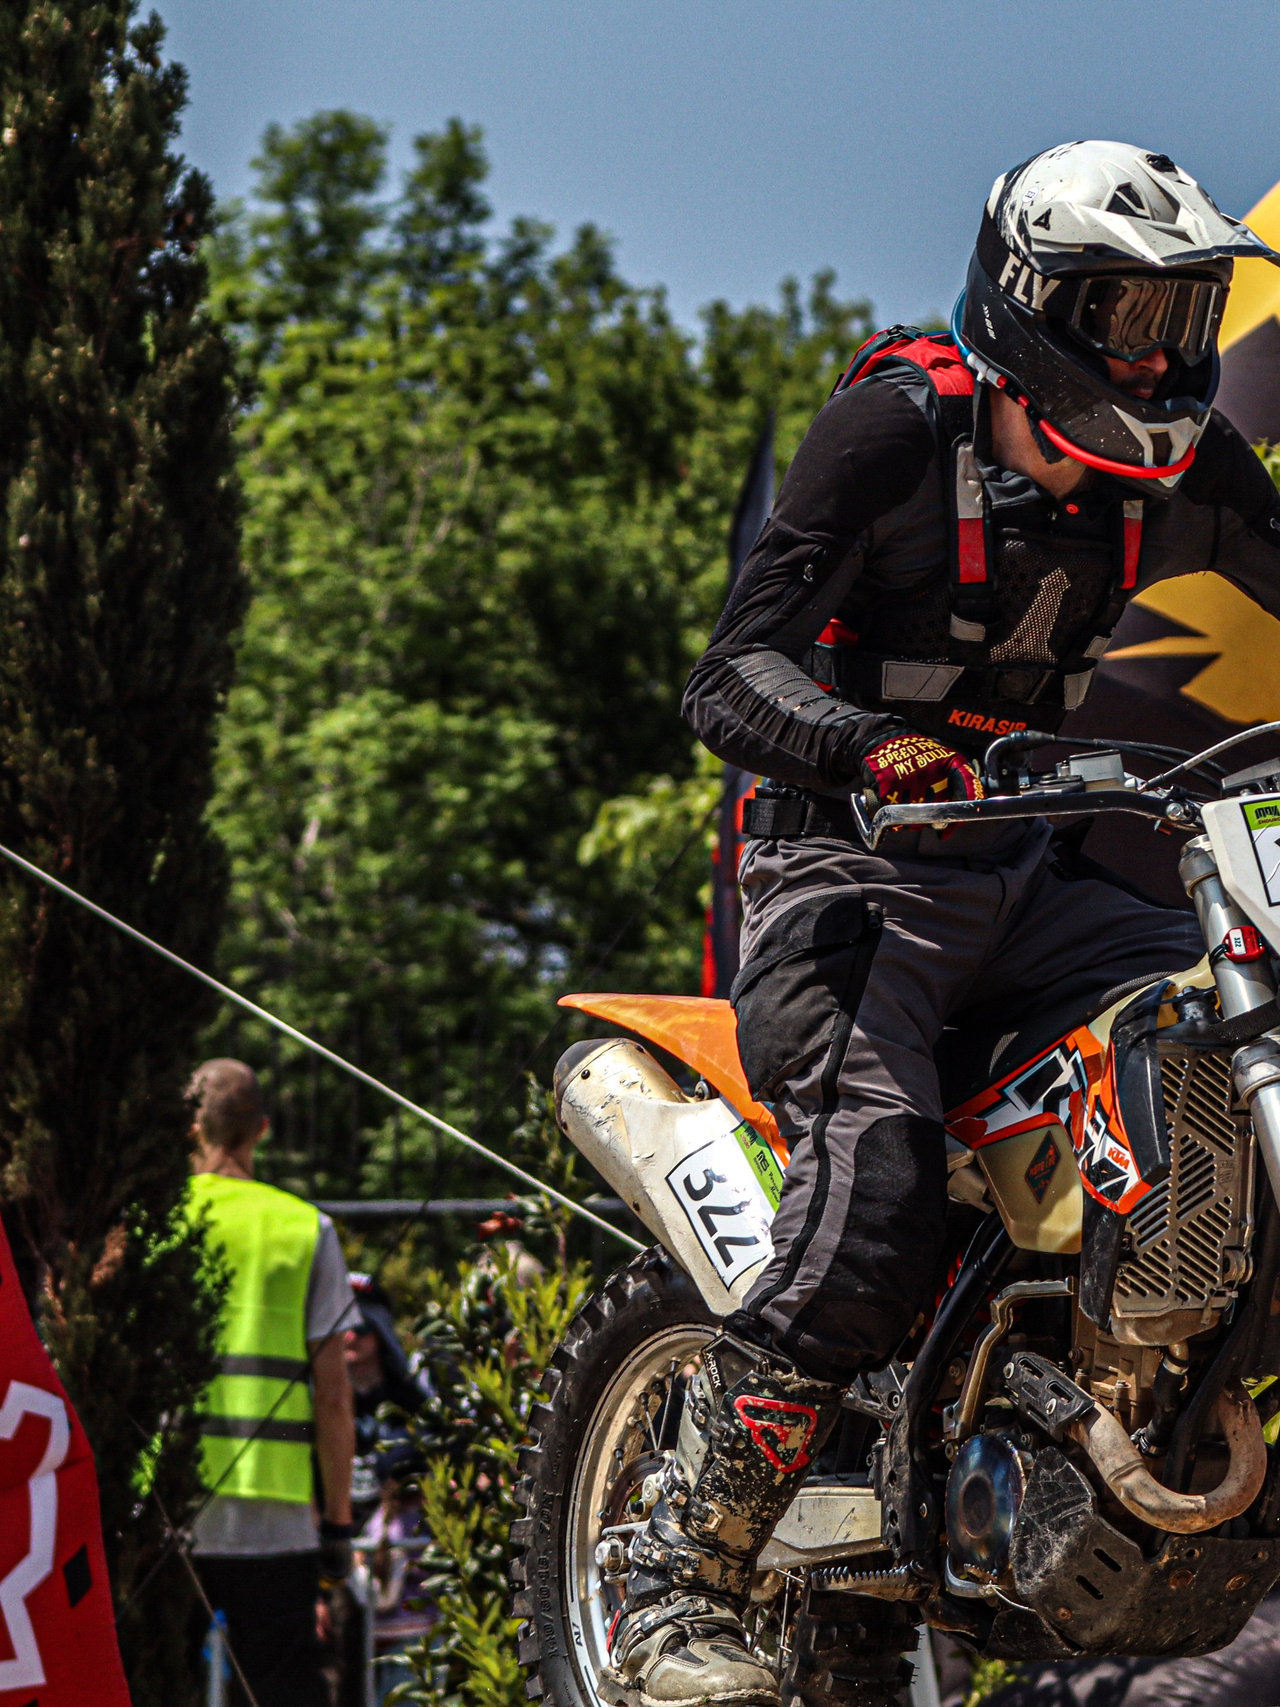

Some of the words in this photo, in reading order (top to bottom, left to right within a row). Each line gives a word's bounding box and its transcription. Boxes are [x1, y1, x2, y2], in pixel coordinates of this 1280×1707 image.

[998, 251, 1062, 311] FLY
[877, 744, 918, 769] SPEED
[893, 758, 916, 780] MY
[915, 748, 956, 768] SOUL
[1233, 937, 1242, 948] 322
[1107, 1146, 1131, 1170] KTM
[683, 1167, 767, 1268] 322
